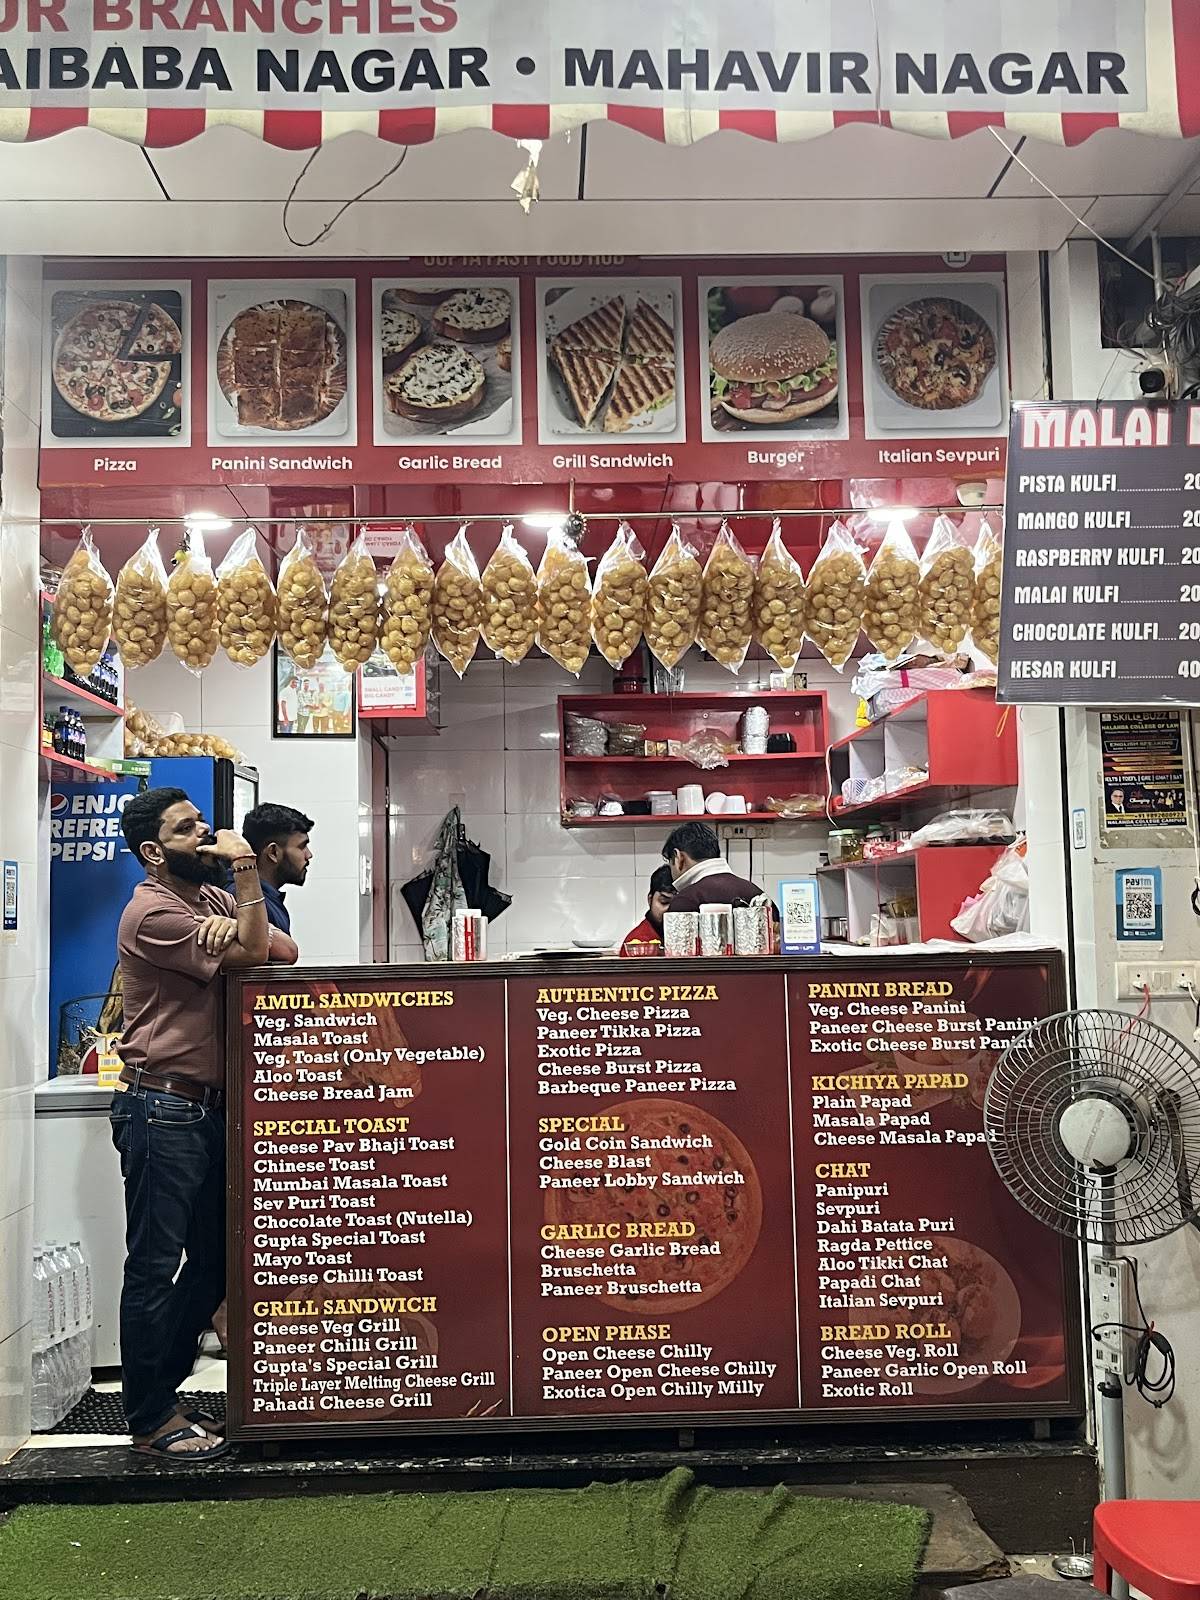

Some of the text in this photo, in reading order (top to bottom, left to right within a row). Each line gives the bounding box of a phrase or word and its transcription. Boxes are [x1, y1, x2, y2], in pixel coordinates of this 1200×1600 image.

[94, 0, 457, 34] BRANCHES
[257, 48, 490, 92] NAGAR
[565, 48, 871, 93] MAHAVIR
[896, 52, 1128, 94] NAGAR
[1021, 407, 1170, 448] MALAI
[94, 457, 137, 471] Pizza
[211, 455, 353, 471] Panini Sandwich
[398, 455, 503, 469] Garlic Bread
[552, 452, 673, 469] Grill Sandwich
[756, 449, 805, 468] Burger
[878, 446, 1000, 466] Italian Sevpuri
[1020, 475, 1064, 492] PISTA
[1071, 474, 1116, 492] KULFI
[1018, 512, 1078, 529] MANGO
[1084, 511, 1130, 528] KULFI
[1016, 548, 1200, 566] RASPBERRY KULFI 20
[1015, 585, 1200, 603] MALAI KULFI 20
[1013, 623, 1200, 642] CHOCOLATE KULFI 20
[1011, 661, 1064, 678] KESAR
[1070, 661, 1116, 678] KULFI
[71, 794, 139, 815] ENJO
[51, 818, 124, 838] REFRE
[50, 841, 116, 861] PEPSI
[536, 986, 718, 1003] AUTHENTIC PIZZA
[808, 982, 952, 998] PANINI BREAD
[254, 991, 453, 1010] AMUL SANDWICHES
[808, 1001, 966, 1019] Veg. Cheese Panini
[254, 1012, 377, 1031] Veg. Sandwich
[537, 1024, 701, 1039] Paneer Tikka Pizza
[253, 1046, 484, 1068] Veg. Toast (Only Vegetable)
[538, 1078, 736, 1096] Barbeque Paneer Pizza
[812, 1074, 968, 1090] KICHIYA PAPAD
[254, 1085, 414, 1102] Cheese Bread Jam
[254, 1118, 409, 1136] SPECIAL TOAST
[539, 1117, 624, 1132] SPECIAL
[254, 1137, 454, 1154] Cheese Pav Bhaji Toast
[539, 1134, 713, 1151] Gold Coin Sandwich
[816, 1163, 870, 1178] CHAT
[254, 1174, 447, 1192] Mumbai Masala Toast
[539, 1171, 744, 1189] Paneer Lobby Sandwich
[816, 1182, 888, 1200] Panipuri
[817, 1201, 880, 1218] Sevpuri
[254, 1210, 472, 1229] Chocolate Toast (Nutella)
[817, 1218, 954, 1234] Dahi Batata Puri
[541, 1222, 695, 1240] GARLIC BREAD
[817, 1237, 932, 1255] Ragda Pettice
[541, 1263, 636, 1277] Bruschetta
[541, 1280, 702, 1296] Paneer Bruschetta
[254, 1297, 436, 1316] GRILL SANDWICH
[819, 1292, 943, 1309] Italian Sevpuri
[542, 1325, 670, 1342] OPEN PHASE
[820, 1324, 951, 1340] BREAD ROLL
[254, 1355, 438, 1376] Gupta's Special Grill
[822, 1360, 1027, 1379] Paneer Garlic Open Roll
[253, 1372, 495, 1396] Triple Layer Melting Cheese Grill
[543, 1380, 764, 1400] Exotica Open Chilly Milly
[253, 1393, 432, 1412] Pahadi Cheese Grill
